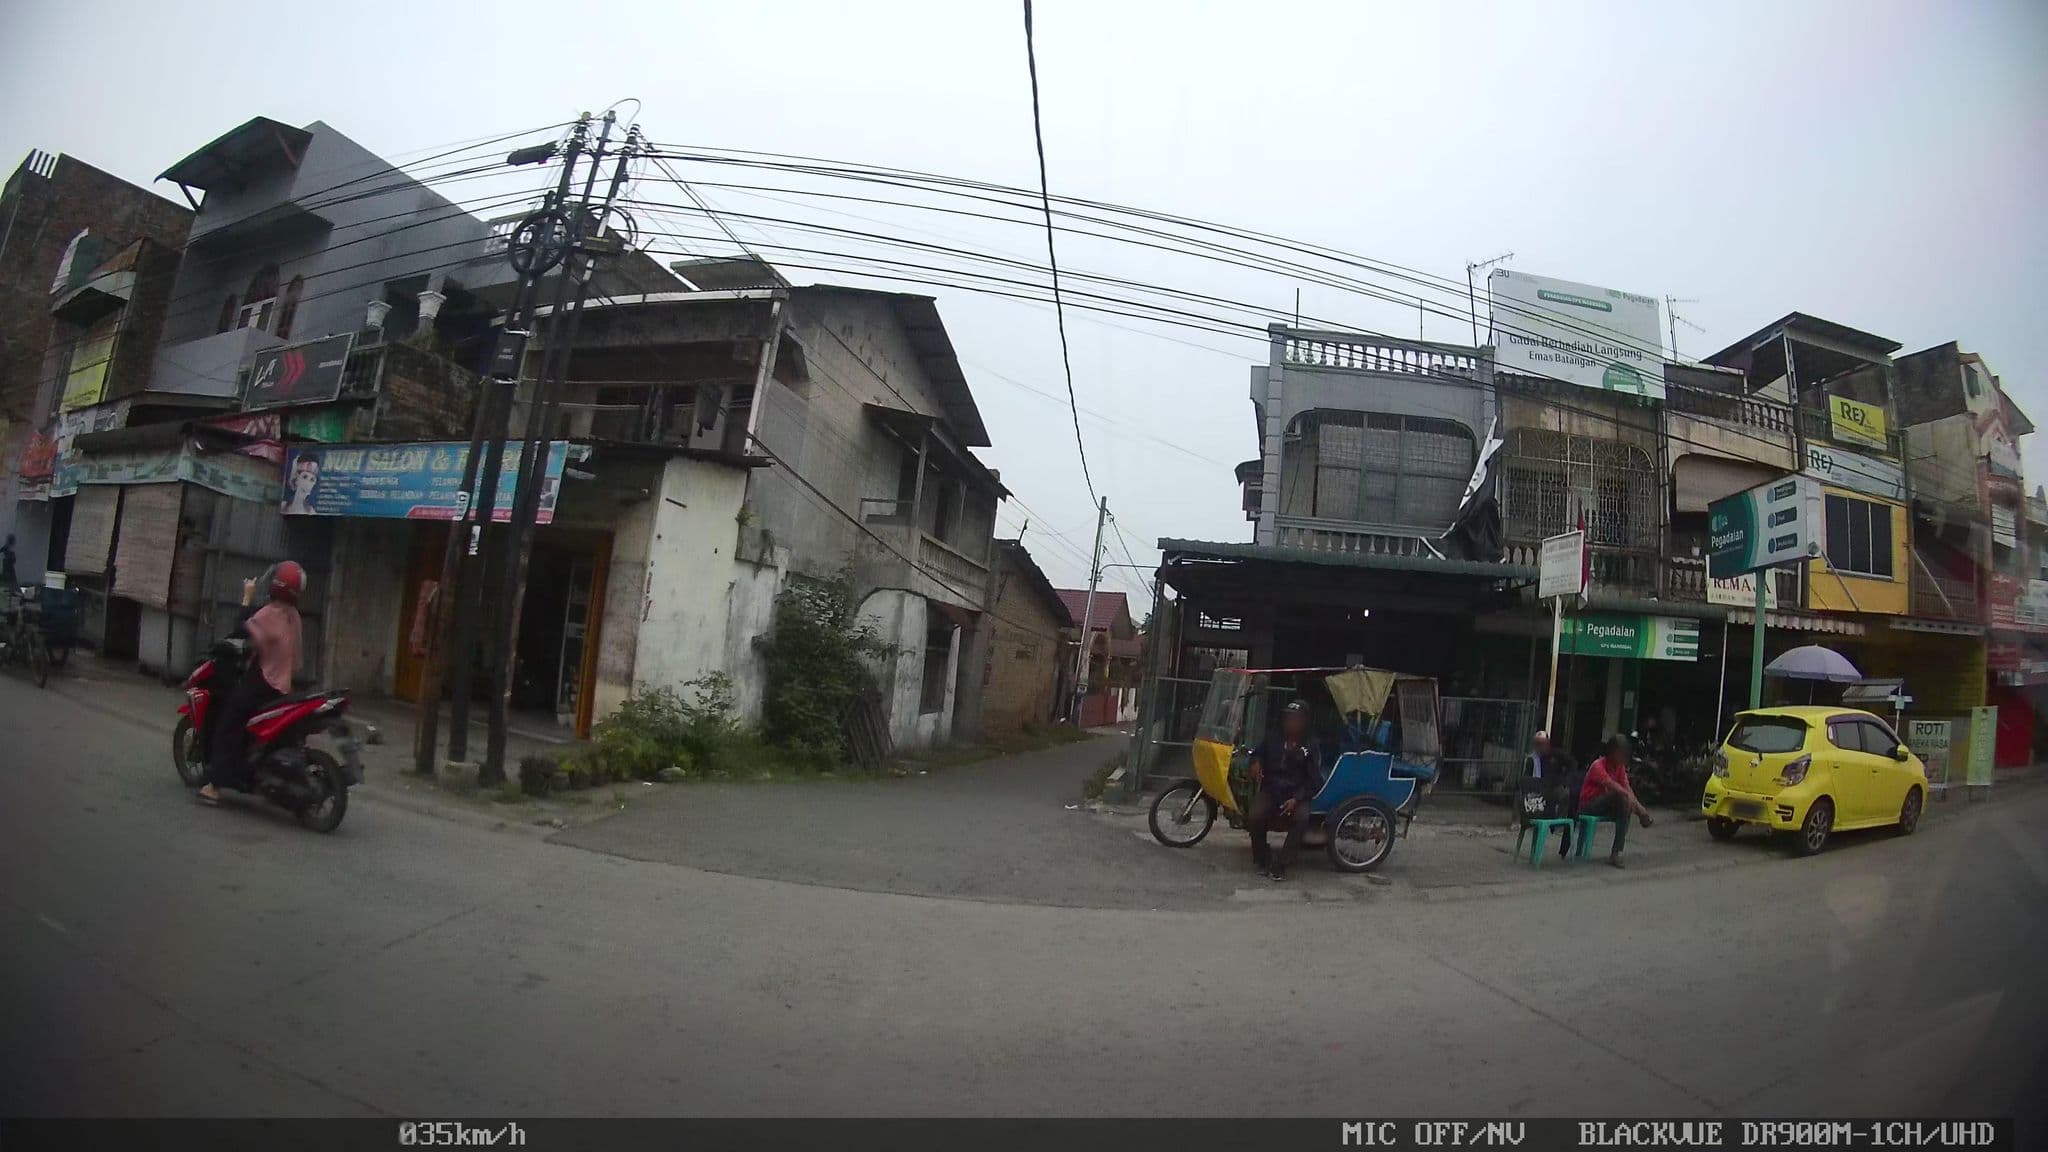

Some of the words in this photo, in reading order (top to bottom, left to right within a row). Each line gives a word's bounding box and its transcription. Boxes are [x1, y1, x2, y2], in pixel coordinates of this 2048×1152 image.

[1509, 334, 1539, 347] Gadai
[1541, 337, 1593, 353] Berhadiah
[1594, 343, 1643, 361] Langsung
[1529, 351, 1553, 363] Emas
[1555, 353, 1597, 368] Batangan
[365, 448, 429, 472] SALON
[1711, 529, 1744, 549] Pegadaian
[1713, 577, 1772, 594] REMAA
[1587, 623, 1635, 638] Pegadaian
[1915, 722, 1944, 737] ROTI
